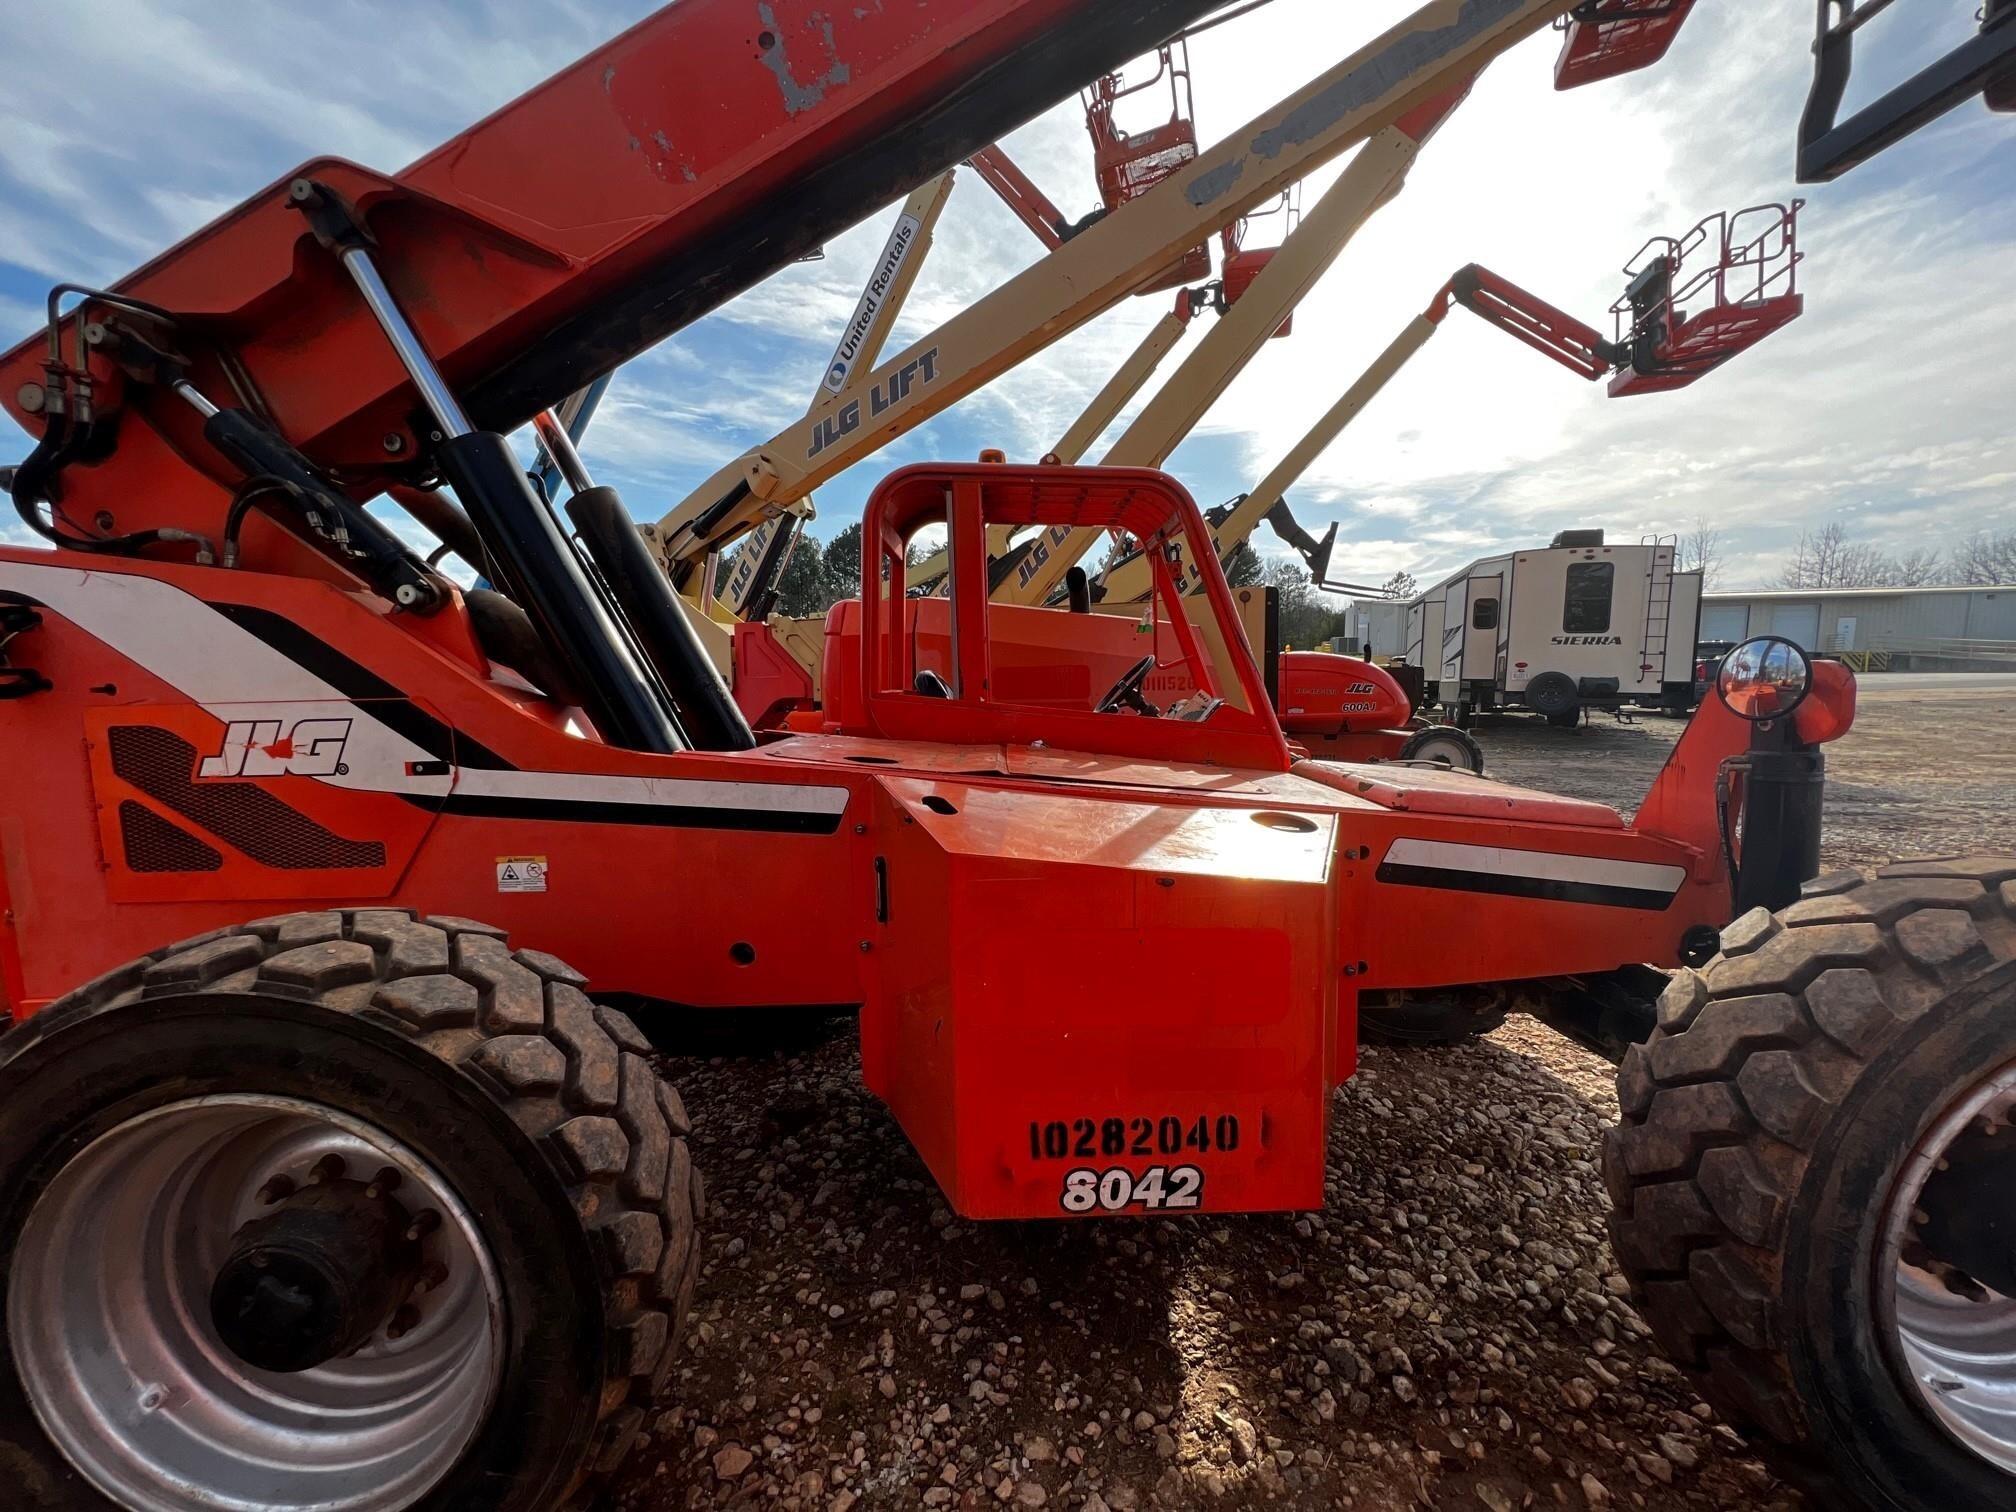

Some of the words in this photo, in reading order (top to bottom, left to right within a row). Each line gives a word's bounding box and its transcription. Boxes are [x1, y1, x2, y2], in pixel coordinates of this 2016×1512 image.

[841, 297, 878, 361] United
[871, 225, 912, 299] Rentals
[807, 399, 860, 459] JLG
[871, 346, 939, 418] LIFT
[730, 560, 752, 604] JLG
[748, 518, 775, 562] LIF
[1018, 540, 1049, 589] JLG
[1551, 636, 1621, 646] SIERRA
[1342, 702, 1377, 712] 600AJ
[1344, 683, 1376, 695] JLG
[197, 718, 353, 778] JLG
[1030, 1115, 1239, 1160] 10282040
[1061, 1164, 1205, 1212] 8042
